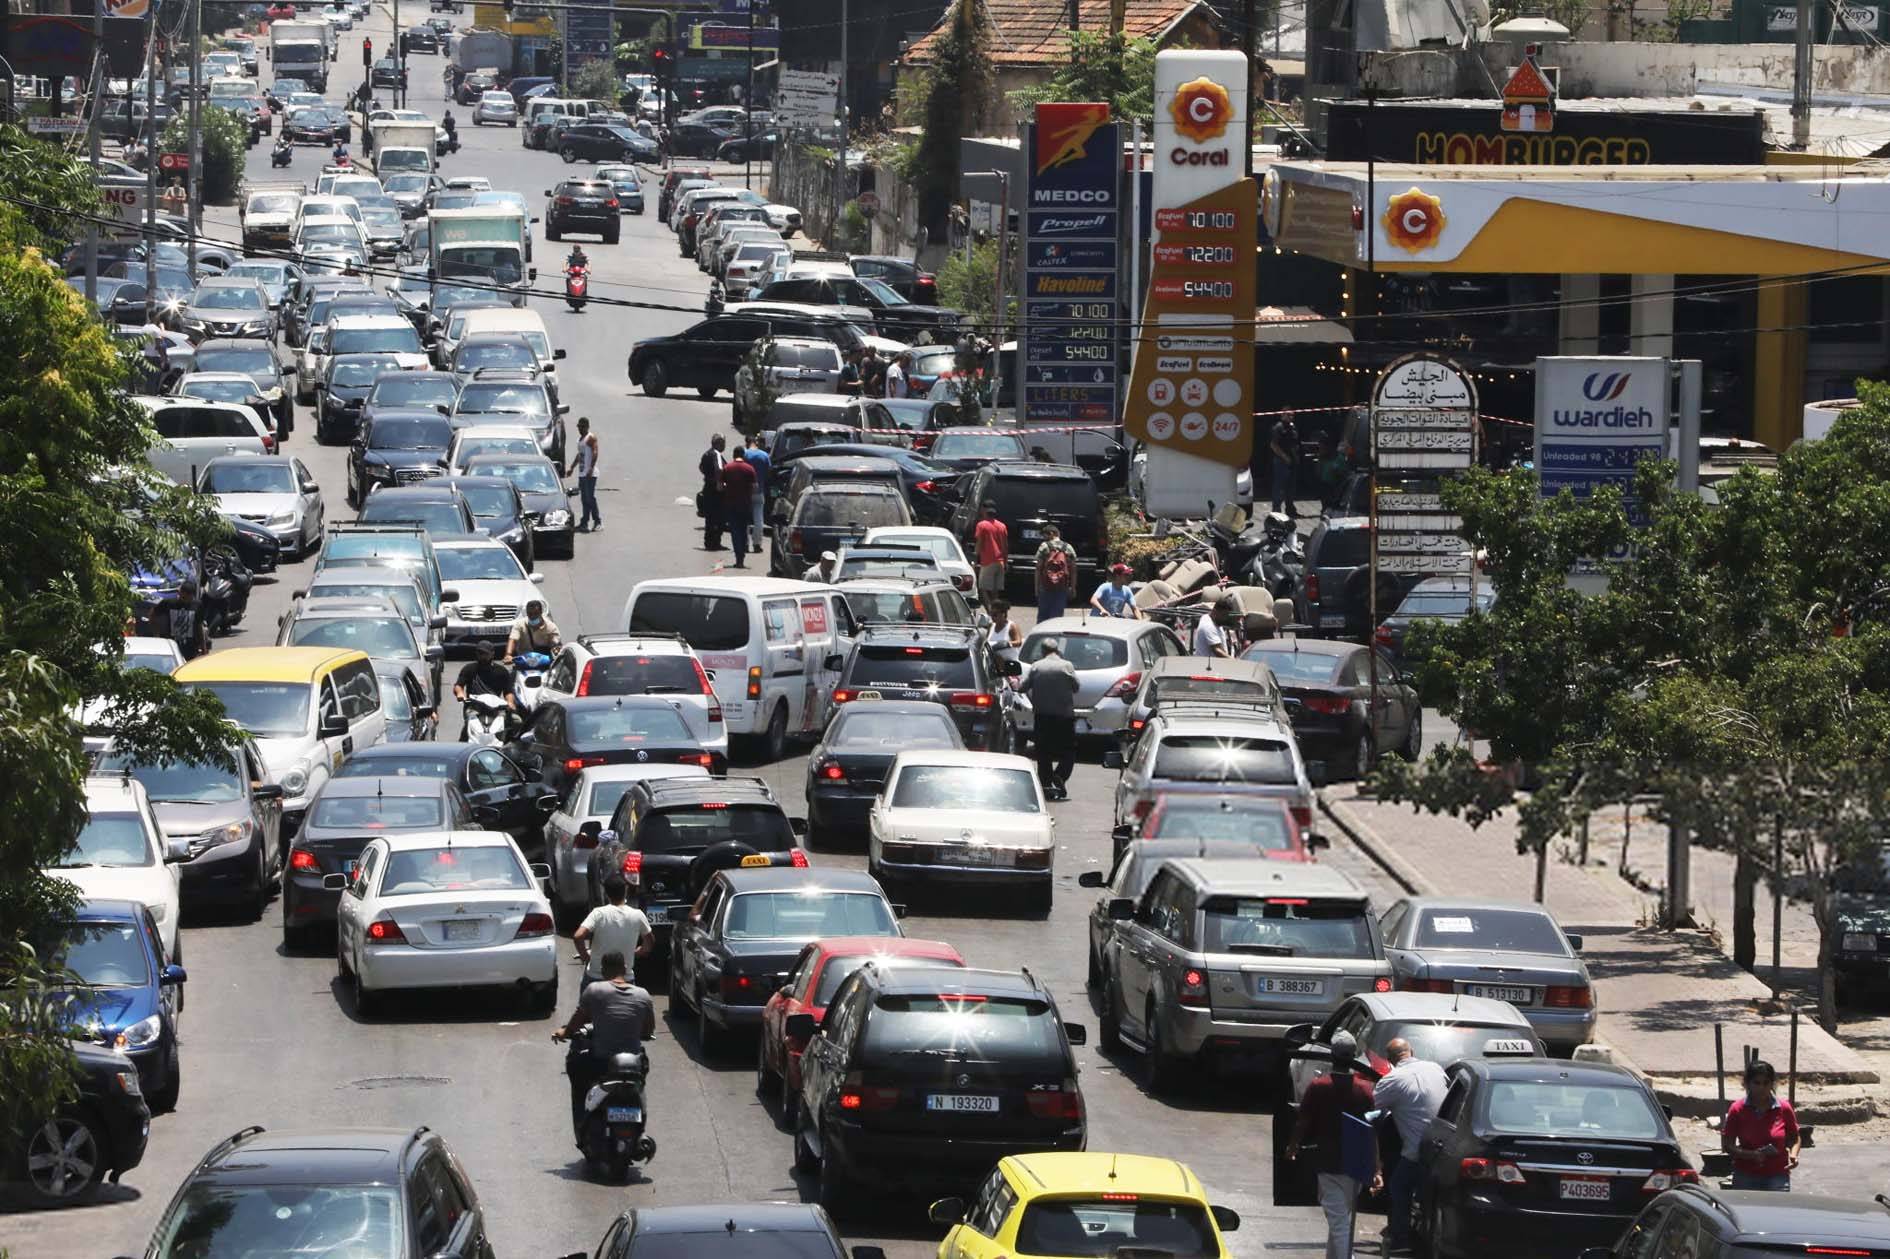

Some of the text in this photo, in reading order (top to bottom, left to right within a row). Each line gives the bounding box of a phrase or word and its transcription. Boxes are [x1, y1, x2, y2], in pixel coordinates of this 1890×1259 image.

[1416, 132, 1651, 165] HOMBURGER
[1170, 148, 1229, 166] Coral
[1034, 190, 1110, 202] MEDCO
[1039, 215, 1106, 232] Propell
[1037, 256, 1067, 266] CALTEX
[1037, 275, 1107, 293] Havoline
[1184, 281, 1233, 298] 54400
[1065, 345, 1108, 360] 54400
[1401, 368, 1448, 386] الجيش
[1553, 406, 1654, 428] wardieh
[1215, 421, 1239, 432] 24/7
[1543, 451, 1587, 461] Unleaded
[902, 690, 921, 699] Jeep
[1266, 979, 1274, 991] B
[1475, 987, 1525, 1001] B 513130
[1494, 1041, 1526, 1051] TAXI
[935, 1097, 993, 1110] N 193320
[1560, 1182, 1610, 1199] P403695
